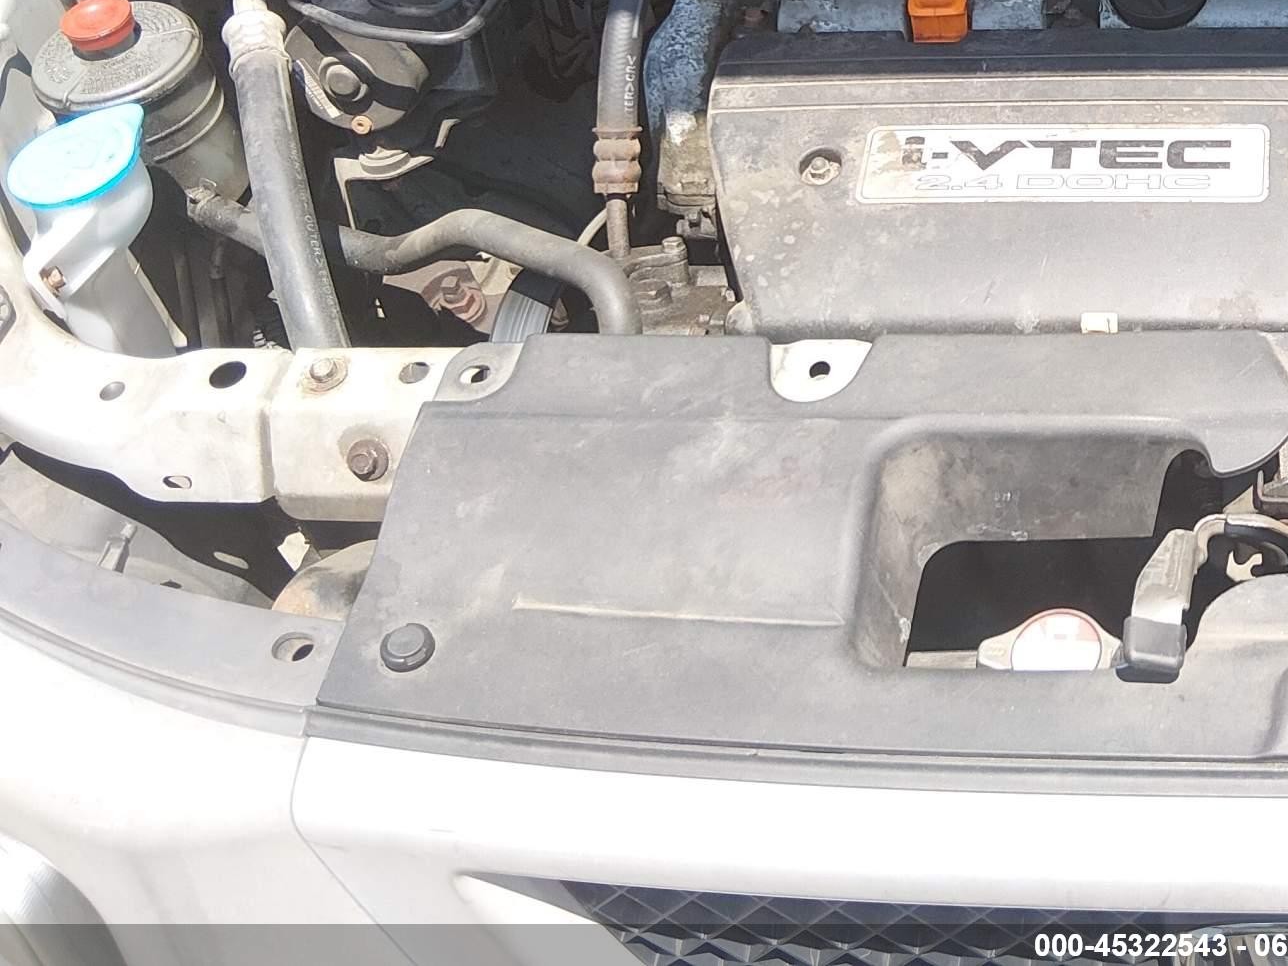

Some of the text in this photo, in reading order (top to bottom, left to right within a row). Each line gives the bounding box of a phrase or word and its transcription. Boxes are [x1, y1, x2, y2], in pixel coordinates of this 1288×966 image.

[902, 136, 1231, 170] i-VTEC
[915, 173, 1211, 191] 2.4 DOHC
